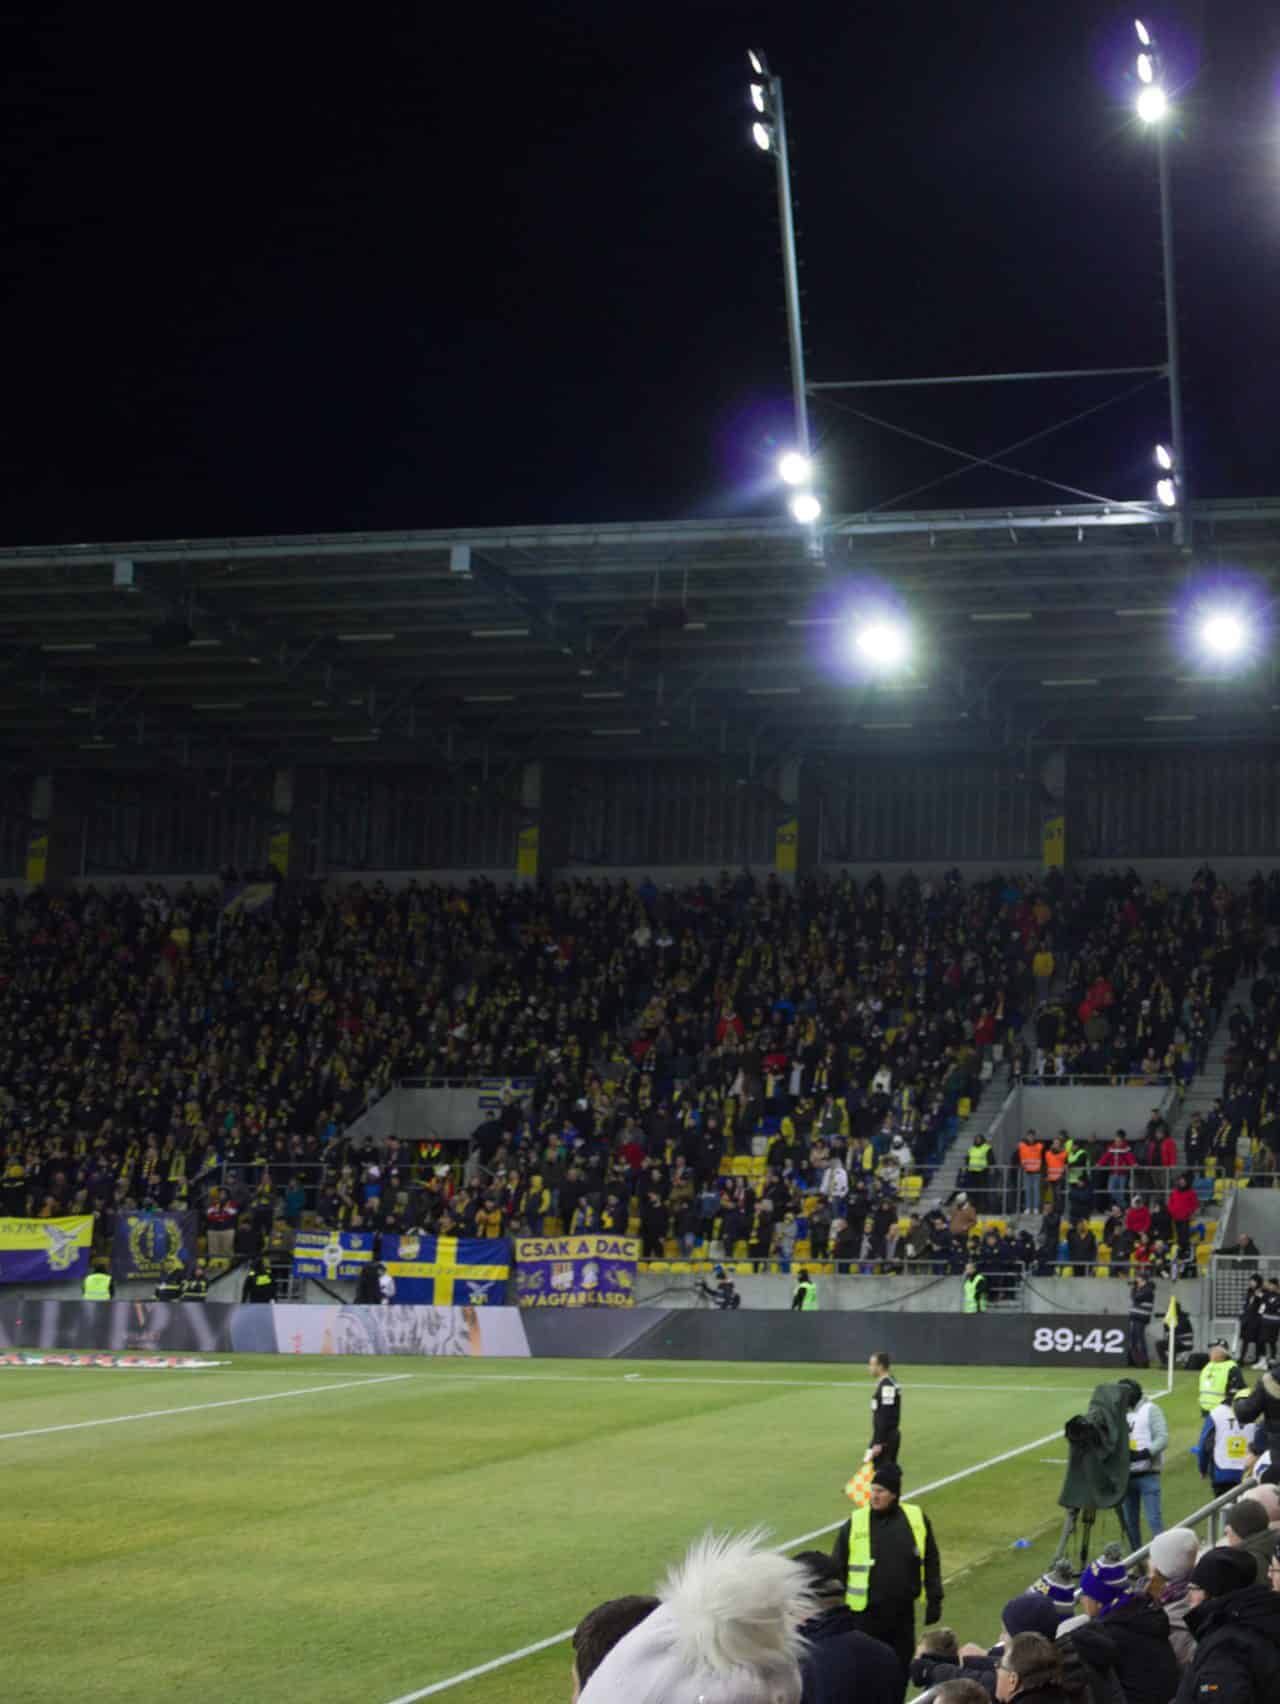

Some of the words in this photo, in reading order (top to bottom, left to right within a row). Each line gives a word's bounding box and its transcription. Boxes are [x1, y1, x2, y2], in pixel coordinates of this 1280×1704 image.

[521, 1242, 568, 1257] CSAK
[577, 1240, 590, 1254] A
[596, 1240, 635, 1257] DAC
[1033, 1328, 1125, 1353] 89:42
